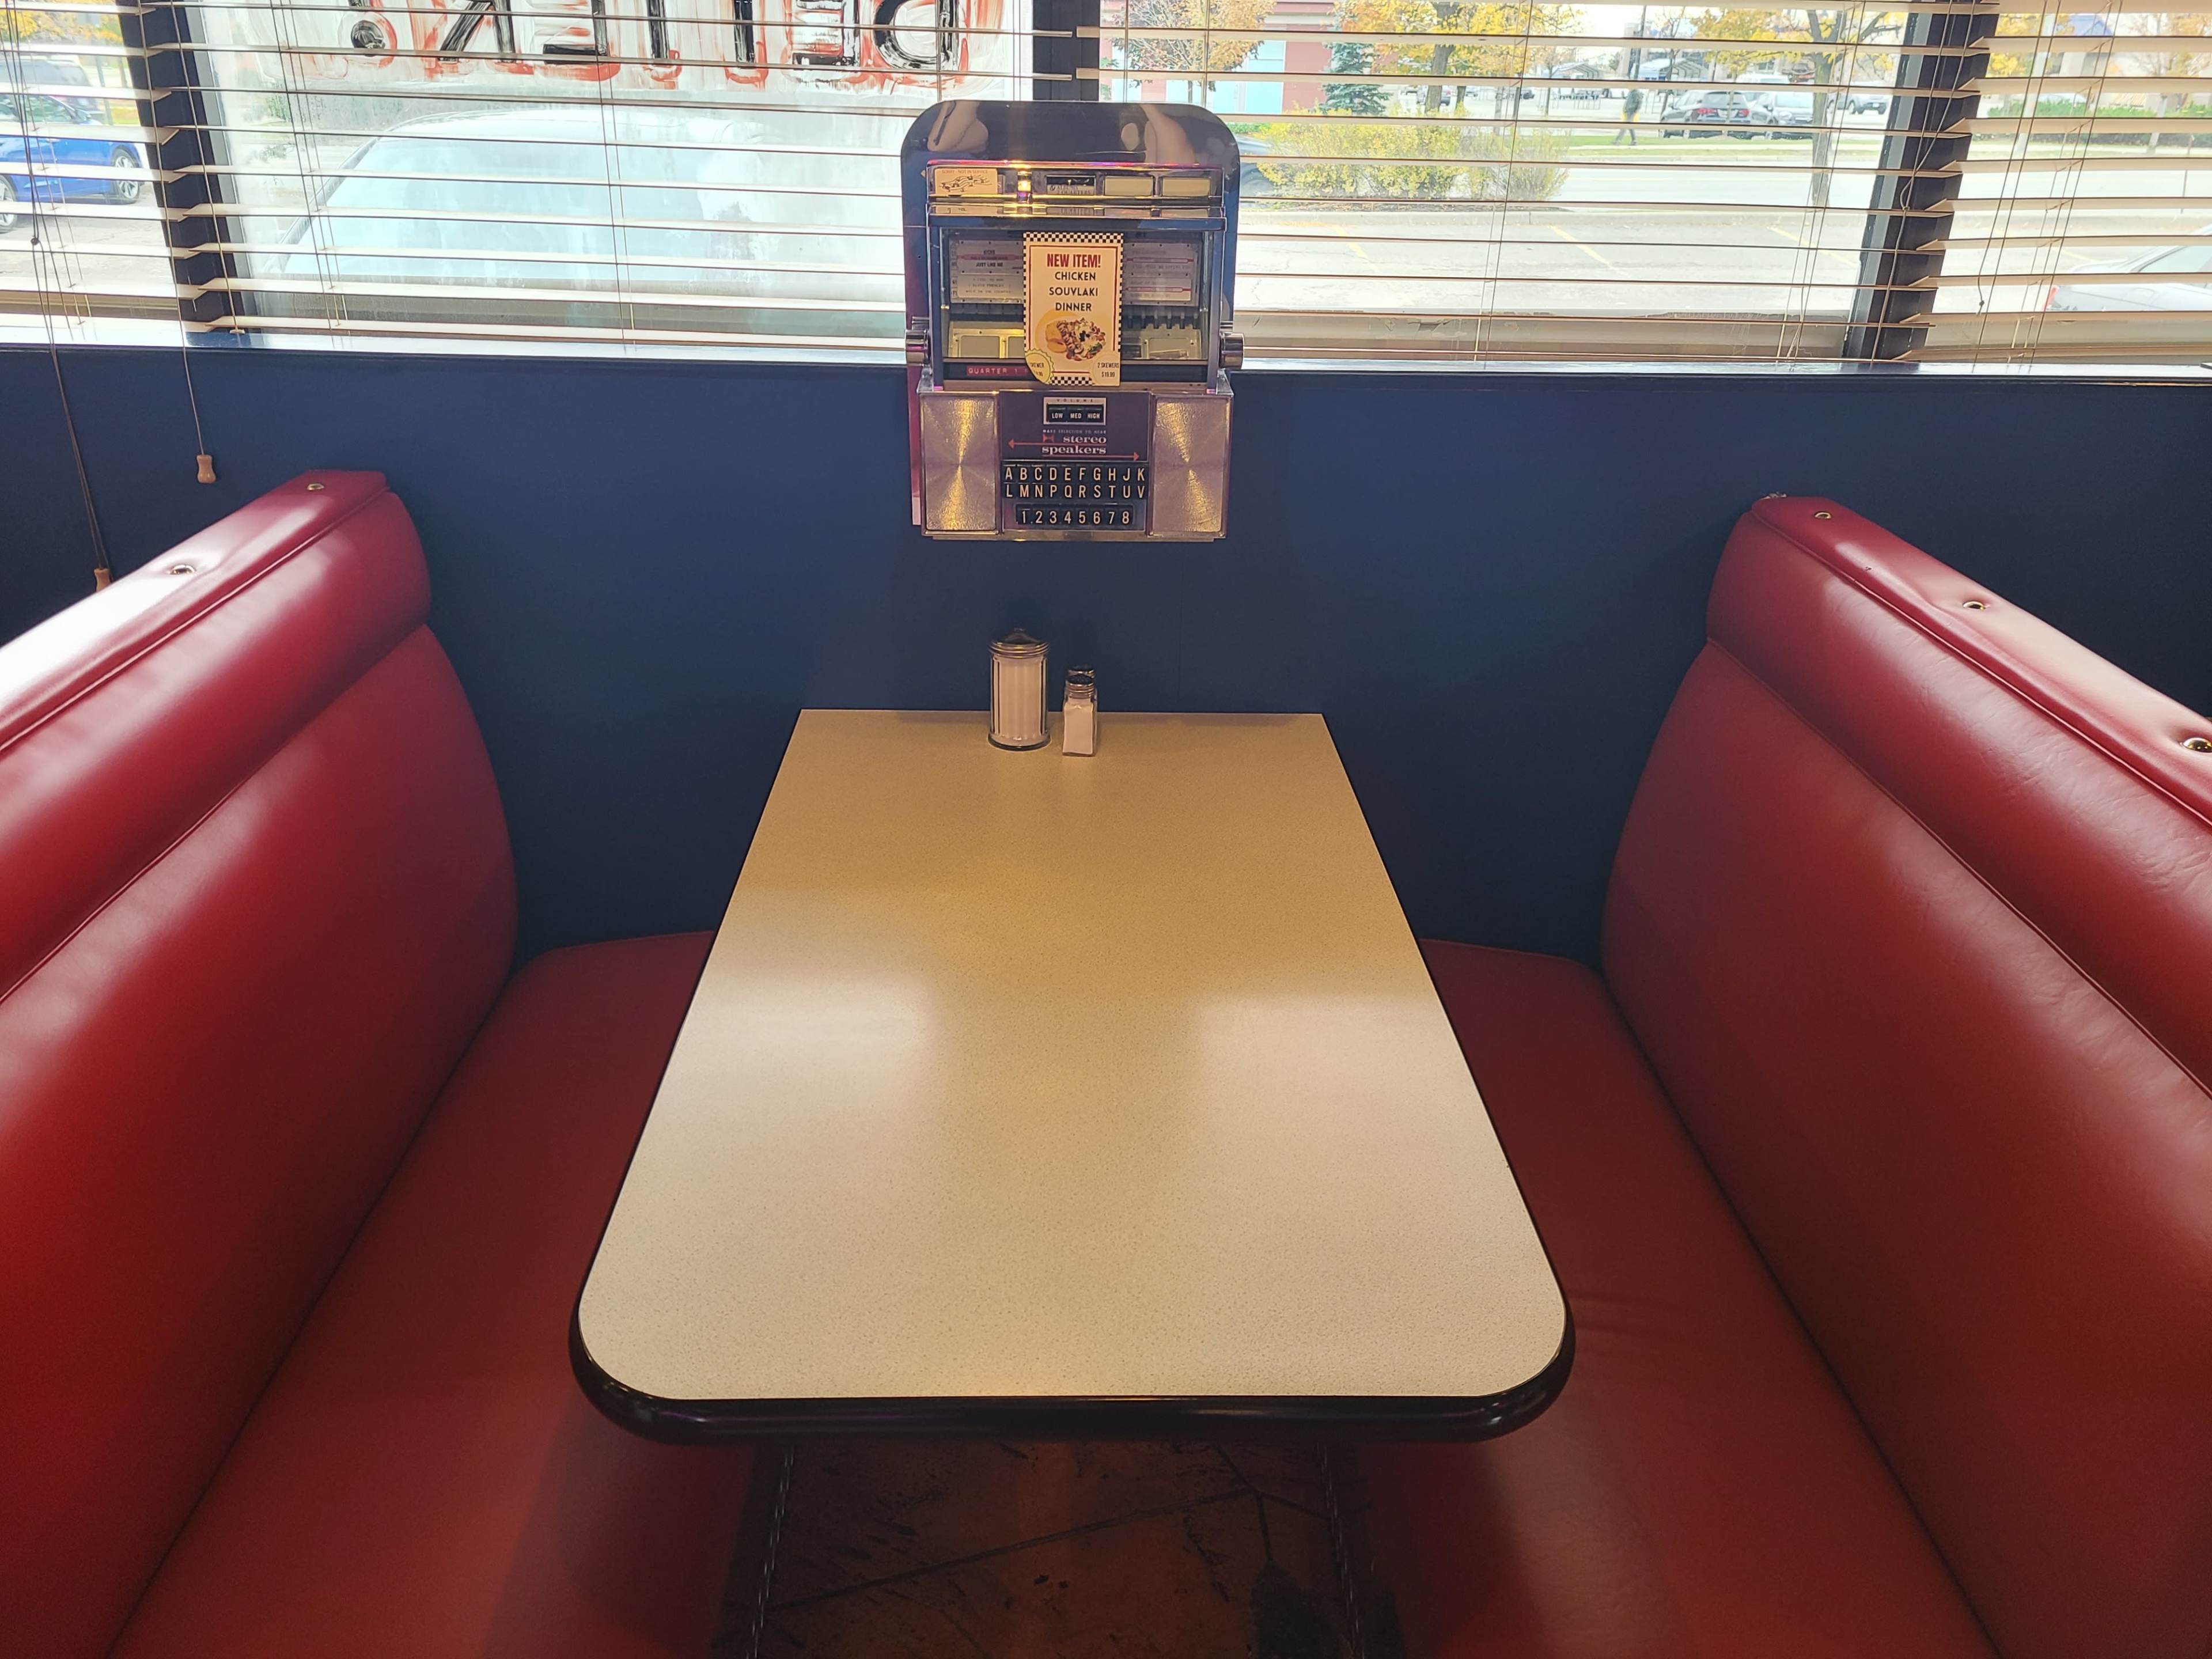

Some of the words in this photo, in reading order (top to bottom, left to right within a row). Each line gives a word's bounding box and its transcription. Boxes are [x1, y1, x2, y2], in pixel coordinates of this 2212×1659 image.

[1047, 253, 1069, 267] NEW
[1073, 254, 1101, 268] ITEM!
[1055, 271, 1096, 281] CHICKEN
[1049, 287, 1098, 296] SOUVLAKI
[1055, 302, 1092, 311] DINNER
[1042, 445, 1106, 455] speakers
[1005, 468, 1013, 480] A
[1020, 468, 1027, 480] B
[1034, 467, 1042, 481] C
[1050, 468, 1057, 480] D
[1065, 468, 1071, 481] E
[1079, 468, 1086, 481] F
[1093, 468, 1101, 481] G
[1108, 468, 1116, 481] H
[1123, 468, 1130, 481] J
[1137, 468, 1145, 481] K
[1006, 485, 1013, 497] L
[1020, 485, 1029, 497] M
[1035, 485, 1043, 497] N
[1050, 485, 1057, 497] P
[1064, 485, 1072, 498] Q
[1079, 485, 1086, 498] R
[1093, 485, 1101, 498] S
[1108, 485, 1116, 498] T
[1123, 486, 1130, 498] U
[1137, 486, 1145, 498] V
[1022, 511, 1026, 523] 1
[1035, 511, 1042, 523] 2
[1050, 511, 1057, 523] 3
[1064, 511, 1071, 524] 4
[1079, 511, 1086, 523] 5
[1093, 511, 1101, 524] 6
[1108, 511, 1115, 524] 7
[1122, 511, 1129, 524] 8
